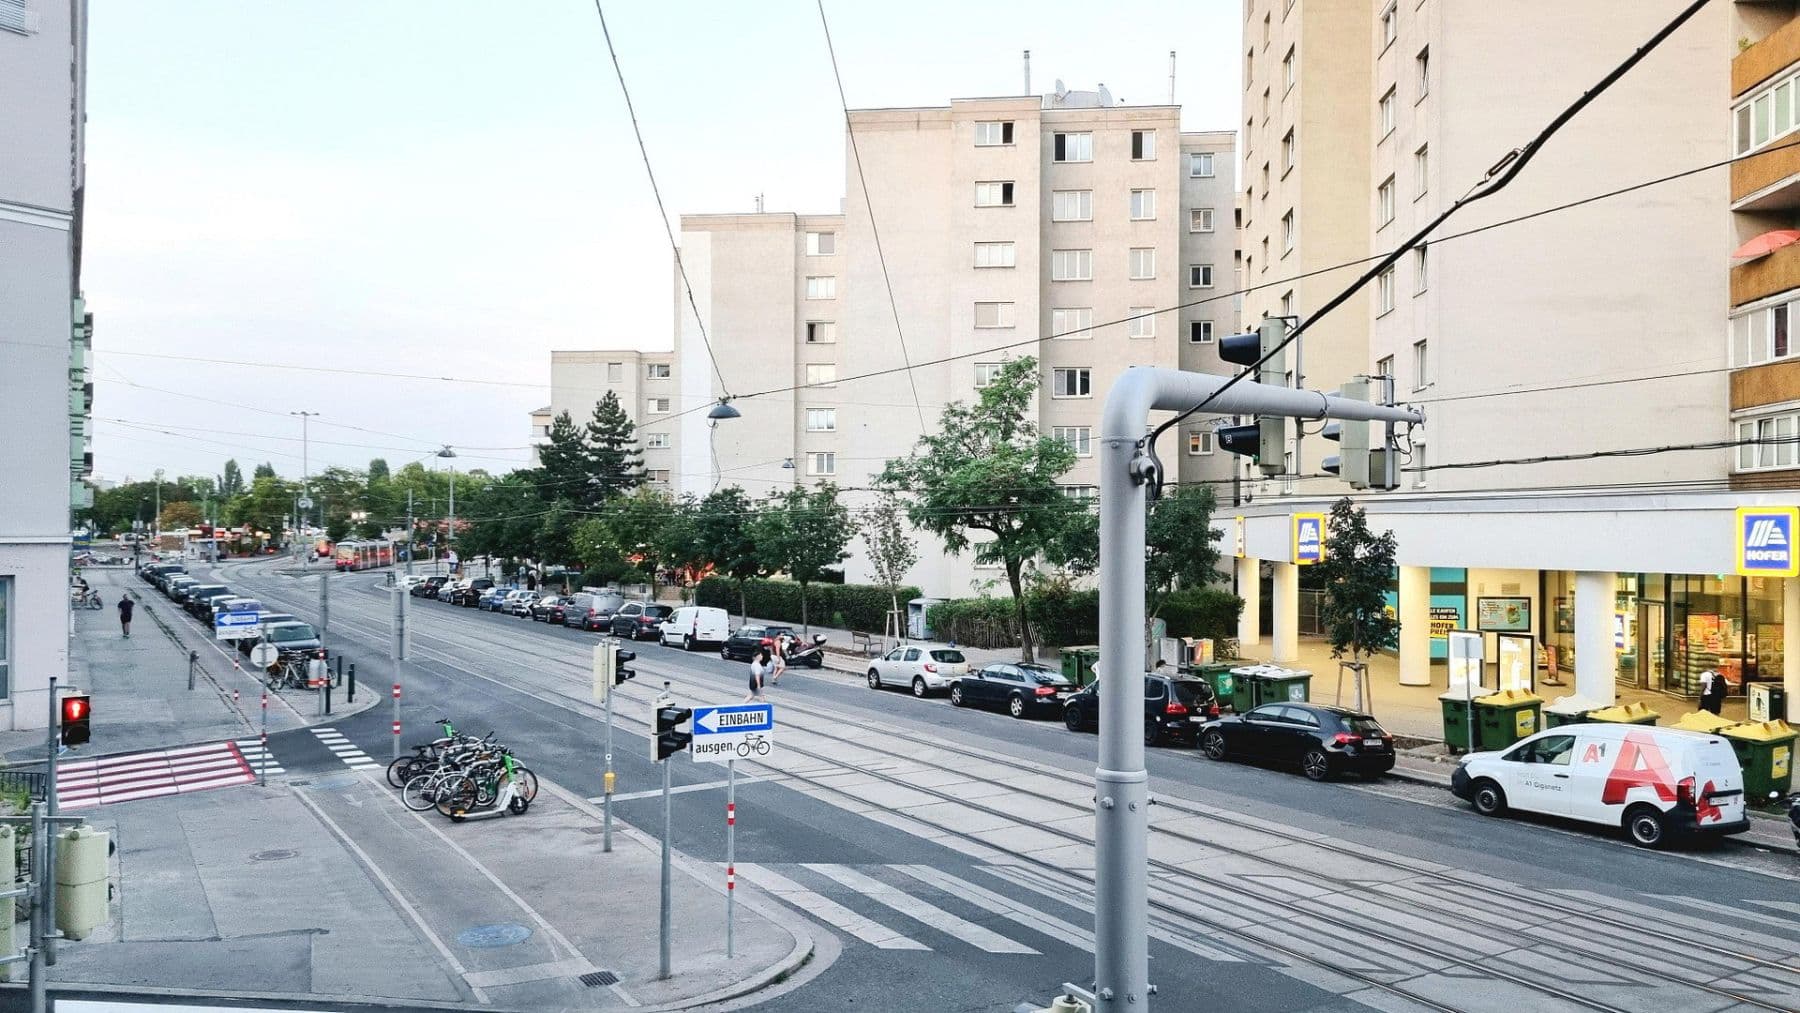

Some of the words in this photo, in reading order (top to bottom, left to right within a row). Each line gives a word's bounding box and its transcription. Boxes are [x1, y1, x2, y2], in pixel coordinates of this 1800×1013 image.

[1747, 550, 1788, 561] HOFER
[719, 713, 764, 726] EINBAHN
[695, 742, 736, 755] ausgen.
[1583, 743, 1606, 763] A1
